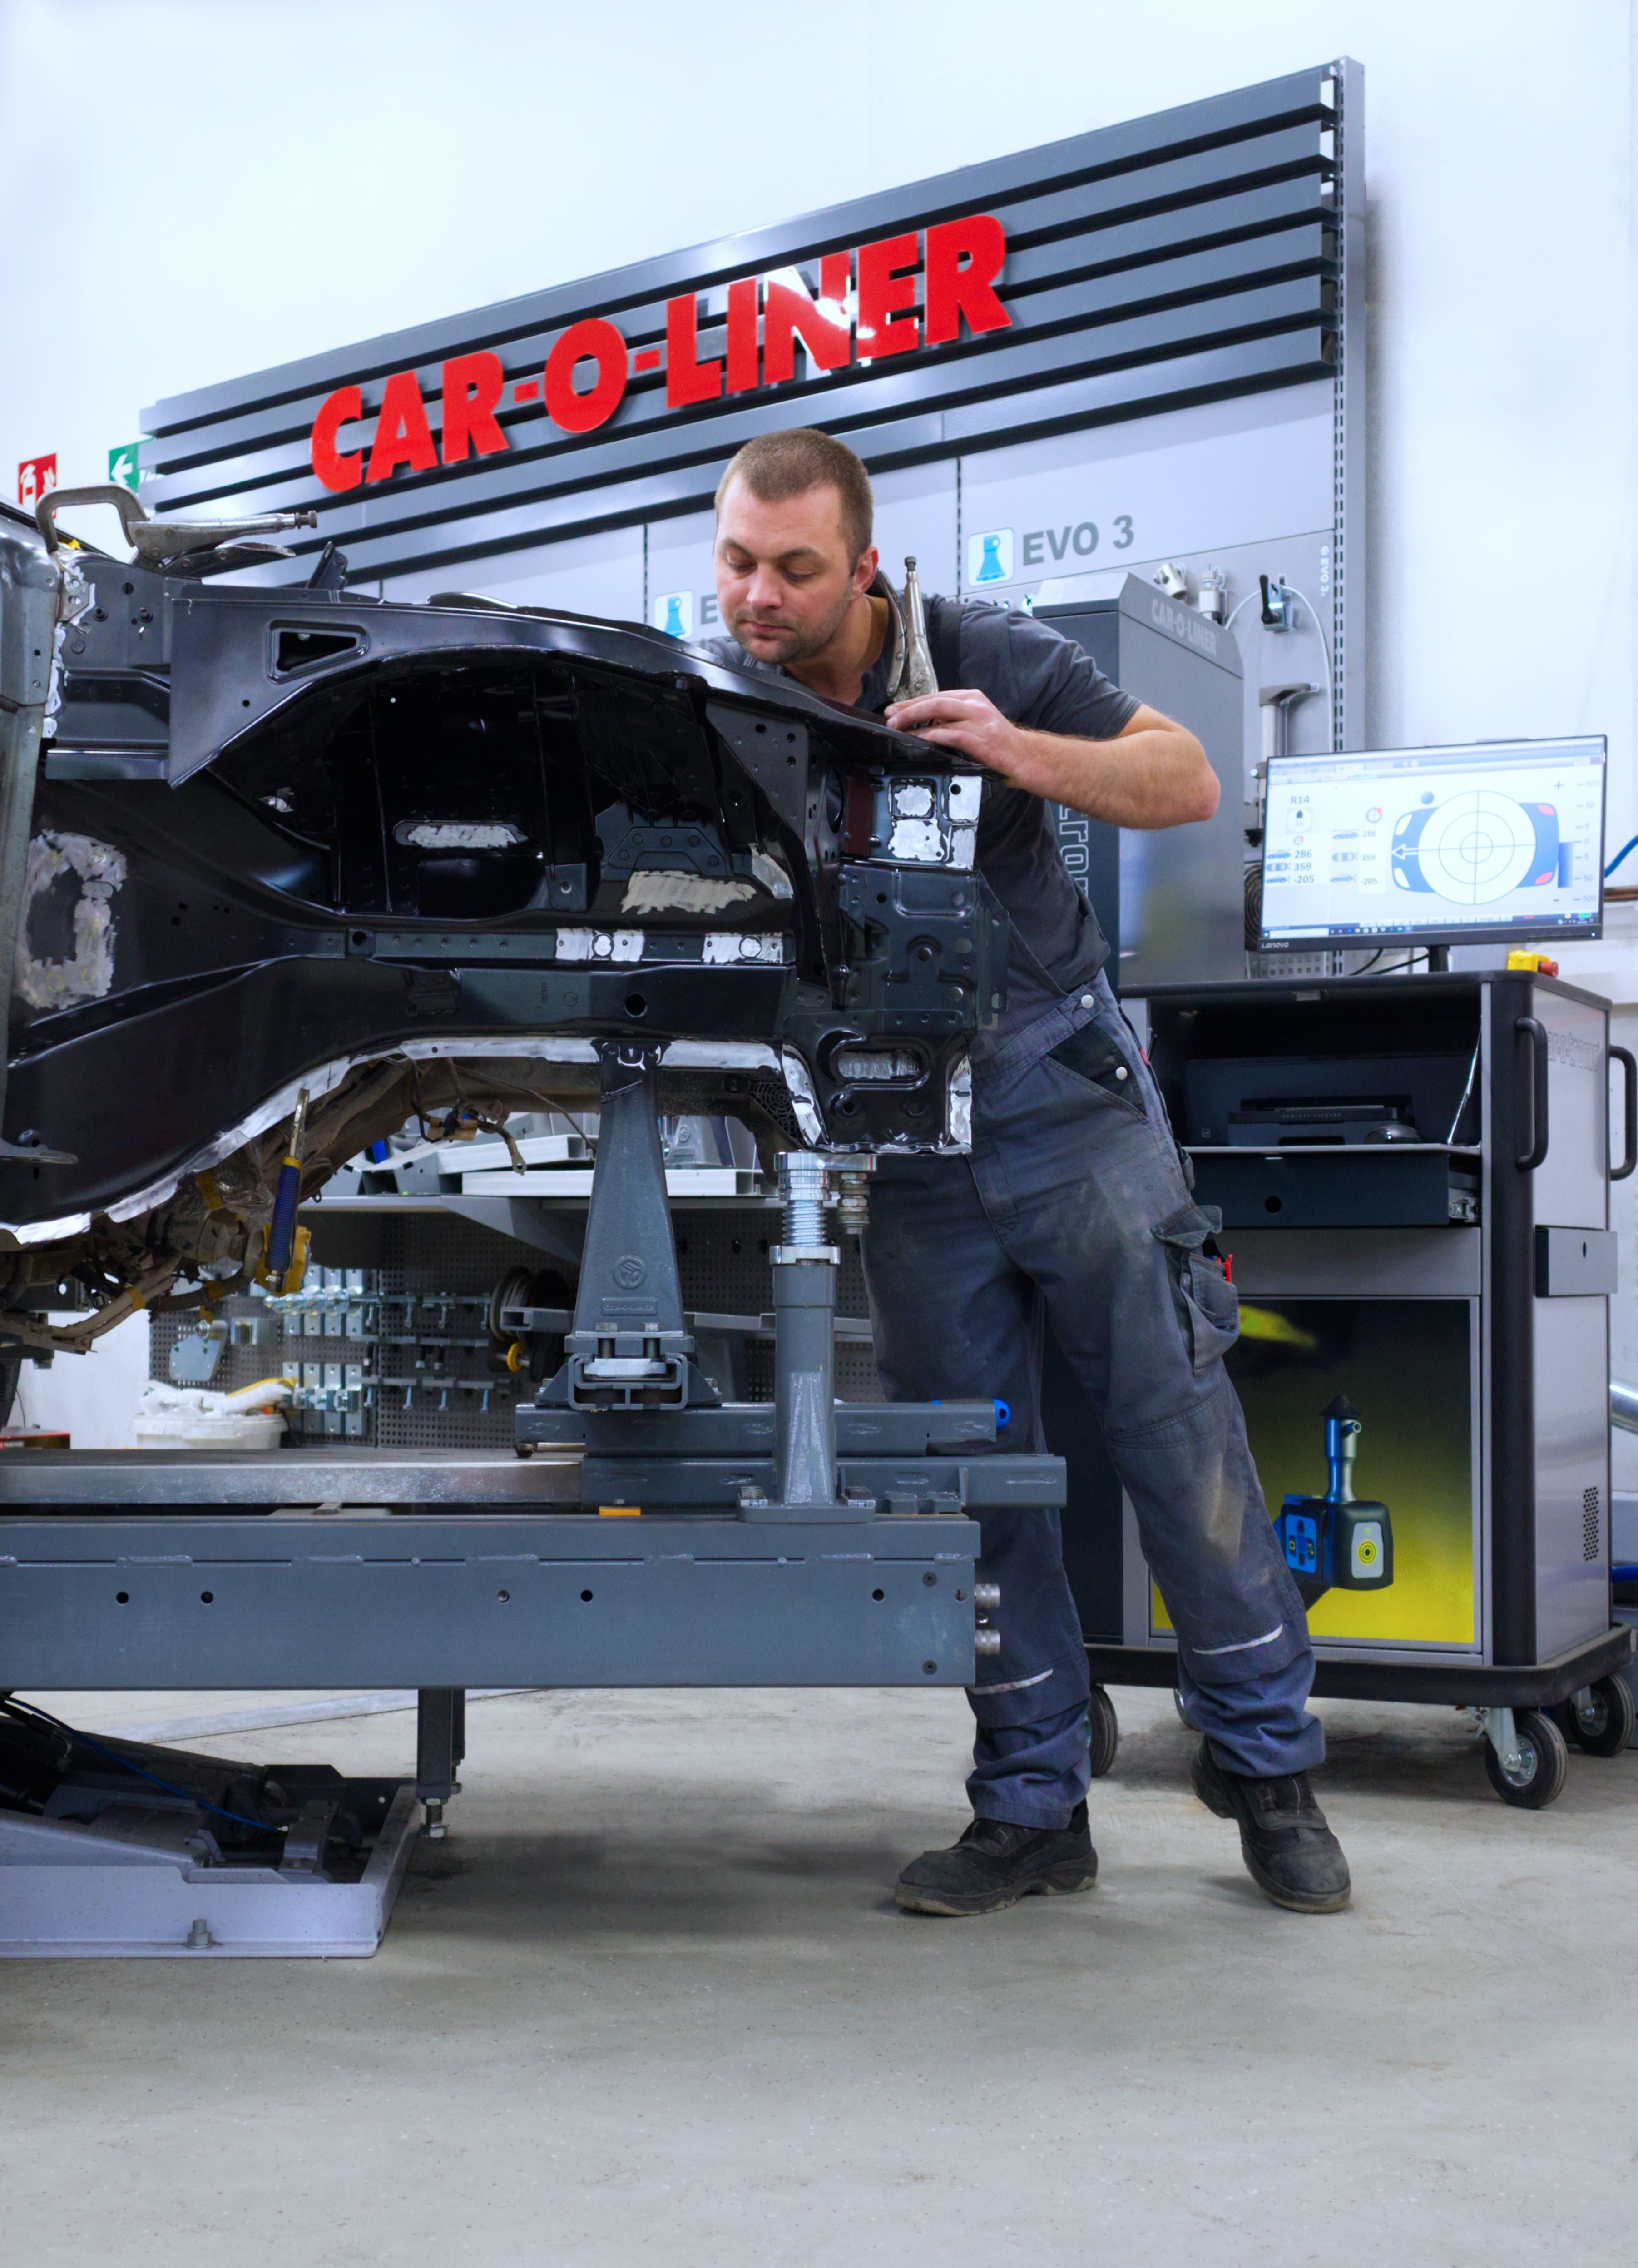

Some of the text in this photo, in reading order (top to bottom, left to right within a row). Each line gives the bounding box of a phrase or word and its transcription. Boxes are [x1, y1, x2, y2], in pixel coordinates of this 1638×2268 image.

[311, 214, 1013, 493] CAR-O-LINER
[1023, 514, 1134, 566] EVO 3
[1152, 598, 1217, 657] CAR-O-LINER
[1291, 795, 1310, 804] R14
[1294, 862, 1312, 871] 359
[1295, 850, 1312, 858] 286
[1294, 875, 1315, 883] -205
[1547, 1031, 1600, 1073] ar-o-tronic
